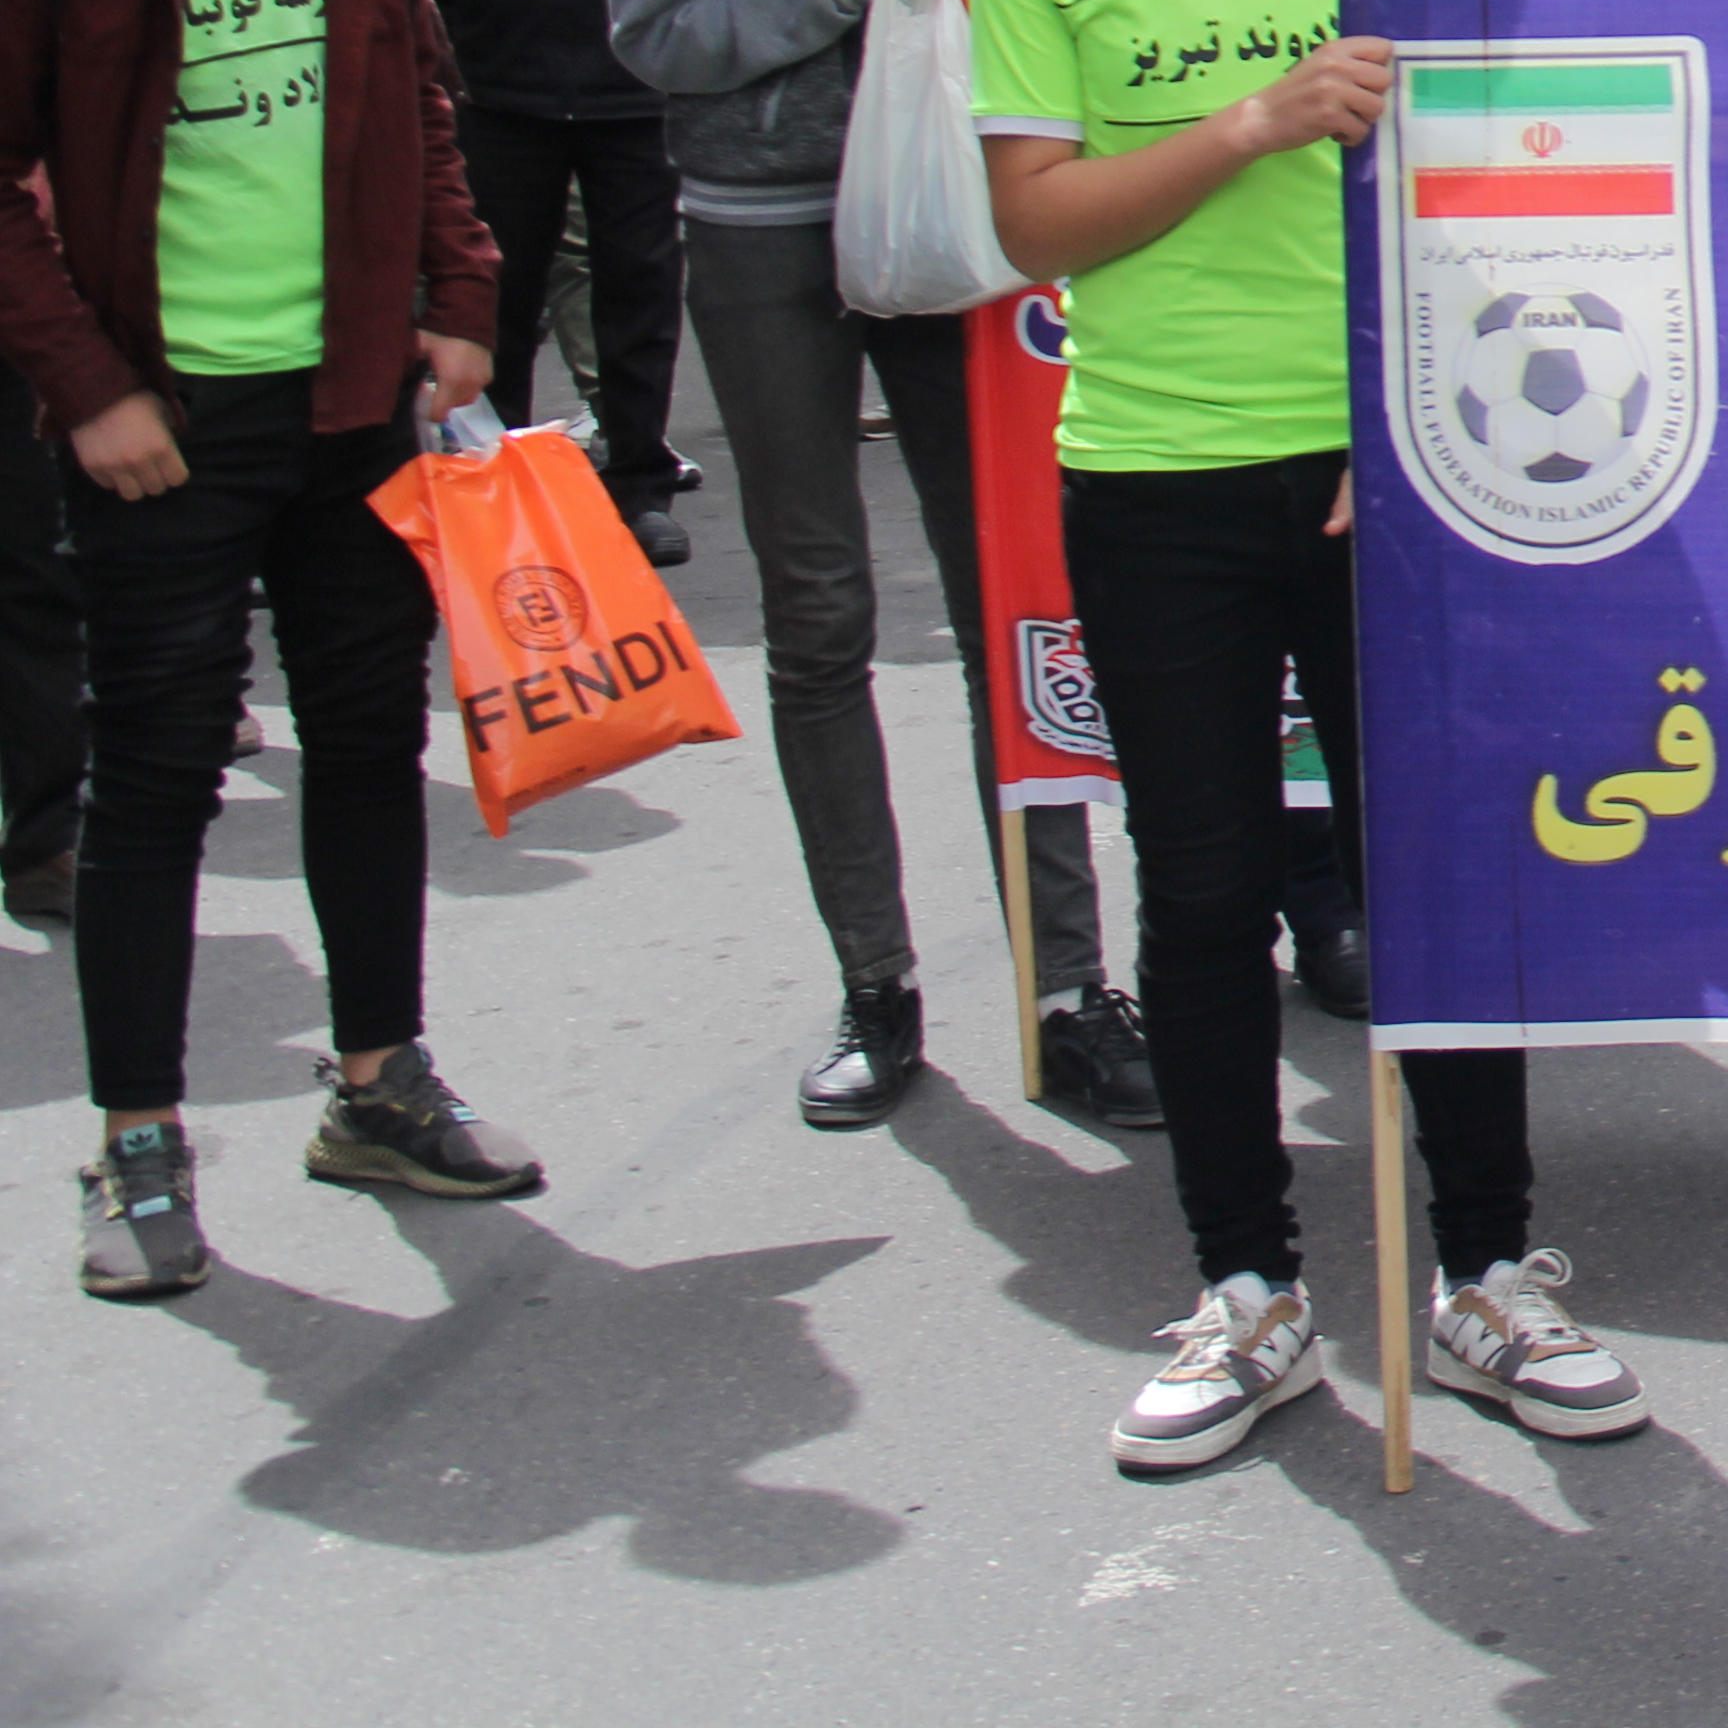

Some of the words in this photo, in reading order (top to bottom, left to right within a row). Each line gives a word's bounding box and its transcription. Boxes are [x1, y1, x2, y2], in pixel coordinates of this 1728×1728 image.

[1126, 20, 1220, 87] تبریز
[1522, 310, 1580, 330] IRAN
[1664, 287, 1684, 347] IRAN
[1414, 291, 1436, 418] FOOTBALL
[1667, 349, 1689, 382] OF
[1424, 421, 1532, 521] FEDERATION
[1627, 387, 1687, 493] REPUBLIC
[1537, 486, 1630, 522] ISLAMIC
[463, 621, 692, 753] FENDI
